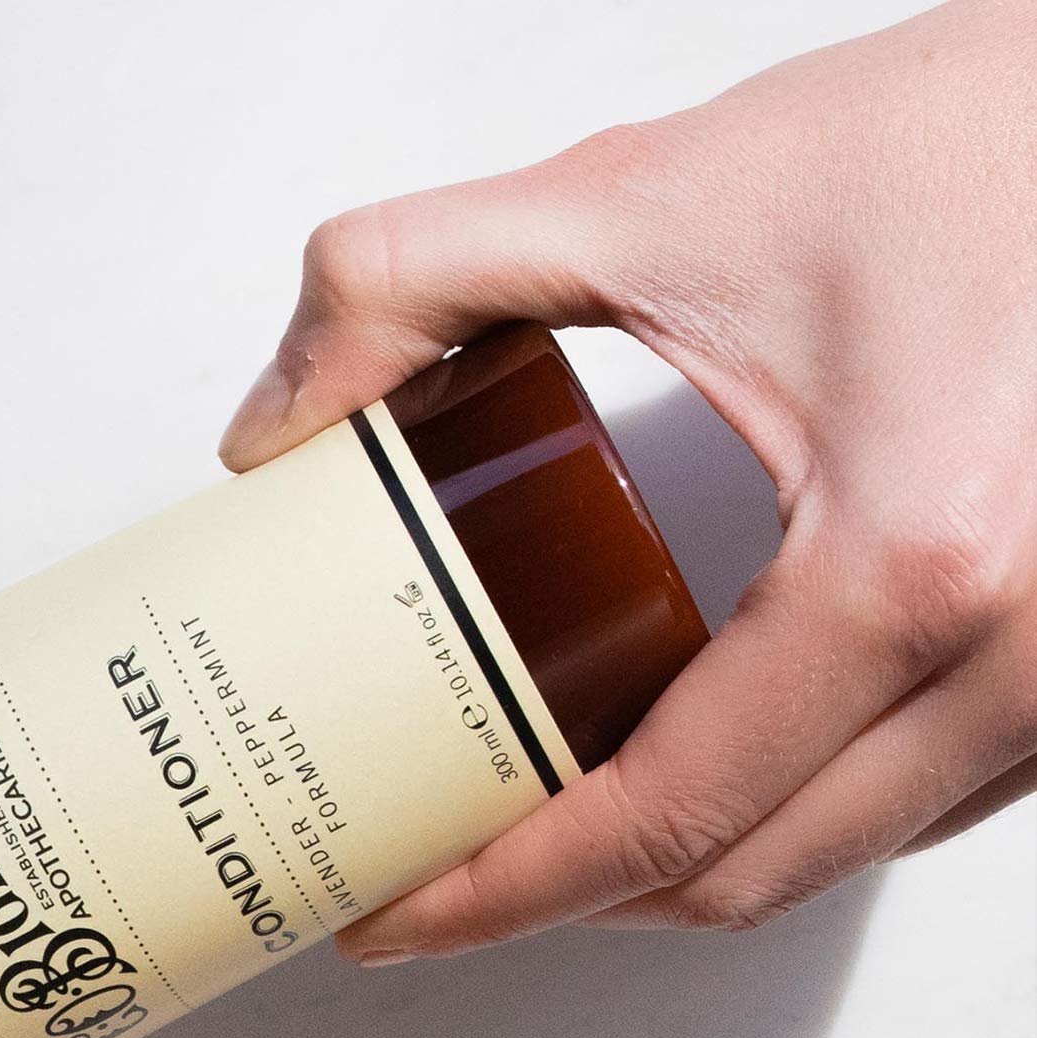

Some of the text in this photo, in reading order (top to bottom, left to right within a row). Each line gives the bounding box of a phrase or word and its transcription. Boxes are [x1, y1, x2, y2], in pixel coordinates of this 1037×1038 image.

[417, 607, 437, 630] oz
[426, 632, 445, 647] fl
[180, 616, 285, 786] PEPPERMINT
[435, 648, 474, 701] 10.14
[478, 728, 502, 751] ml
[266, 705, 347, 833] FORMULA
[491, 752, 519, 784] 300
[106, 645, 299, 953] CONDITIONER
[291, 816, 363, 918] LAVENDER
